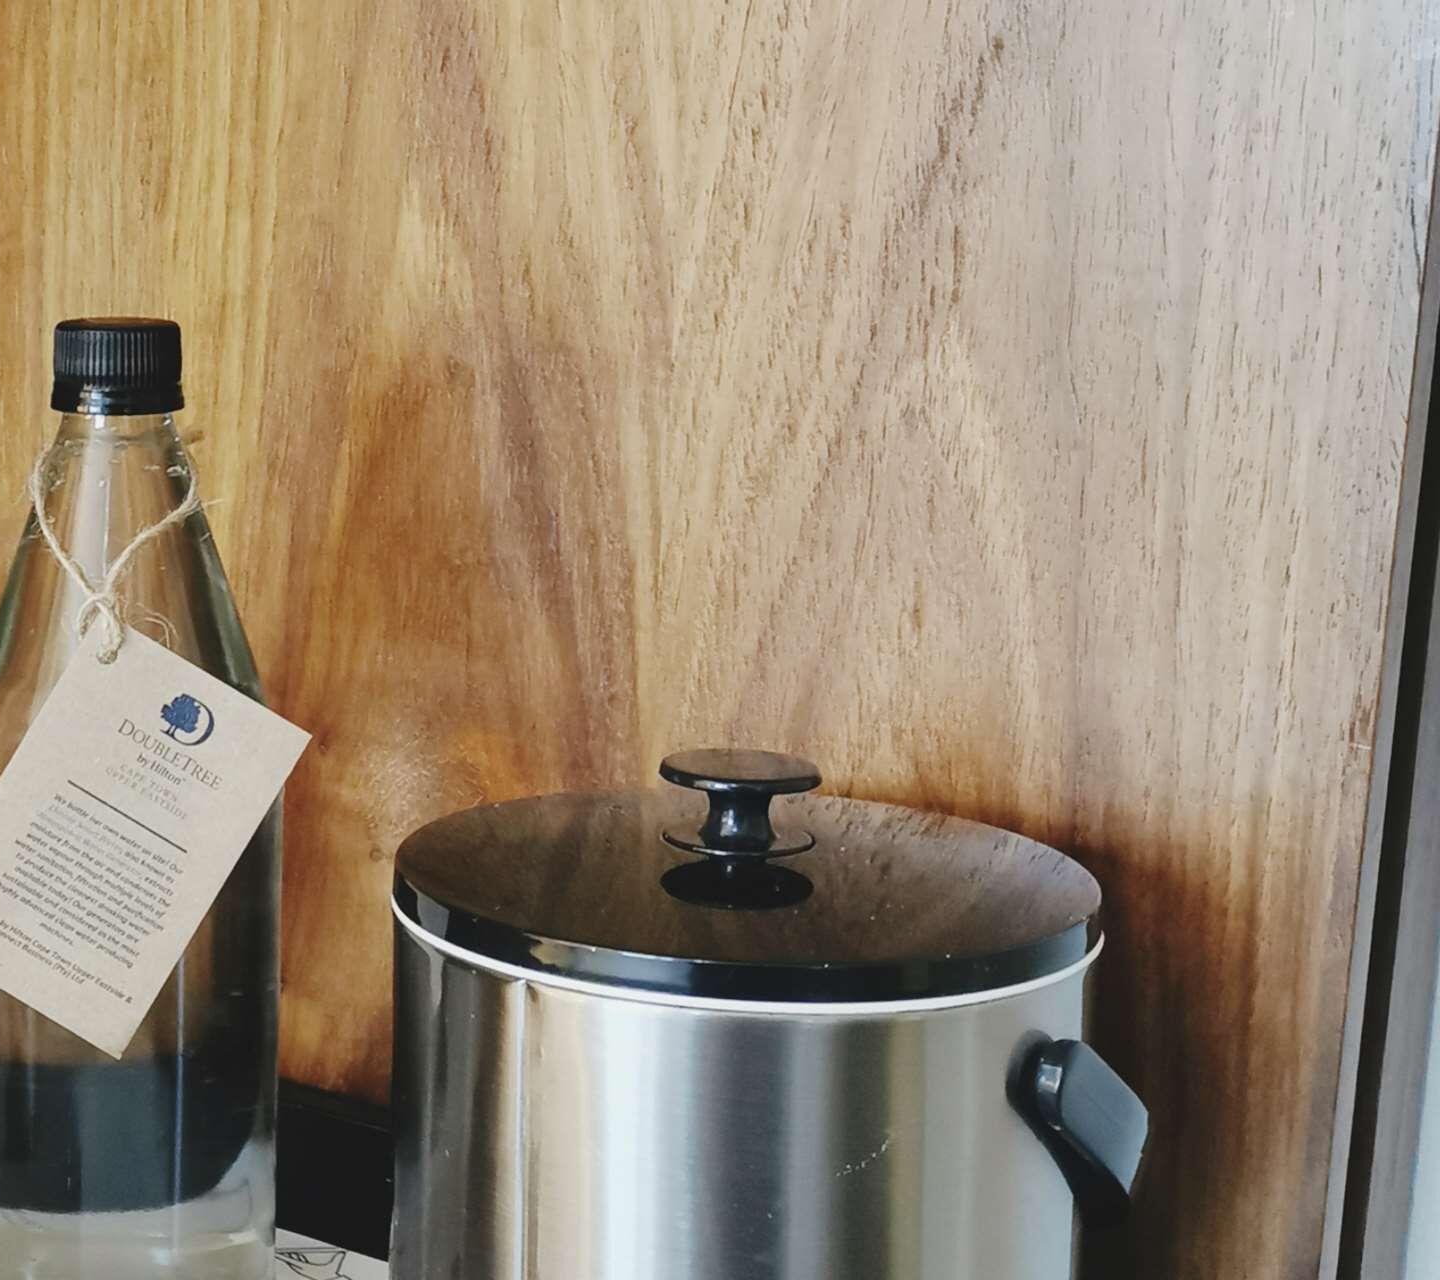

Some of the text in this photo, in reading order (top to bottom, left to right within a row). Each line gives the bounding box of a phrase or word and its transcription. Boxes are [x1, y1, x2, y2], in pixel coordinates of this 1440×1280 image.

[118, 762, 180, 804] CAPE TOWN
[134, 752, 150, 768] by
[14, 837, 37, 855] water
[107, 892, 124, 907] and
[25, 831, 49, 849] water
[73, 859, 105, 883] through
[102, 877, 134, 901] multiple
[133, 895, 156, 913] levels
[152, 906, 166, 920] of
[29, 819, 64, 844] moisture
[60, 838, 82, 856] from
[80, 850, 95, 863] the
[104, 864, 122, 879] and
[157, 896, 172, 909] the
[66, 800, 91, 819] bottle
[101, 823, 119, 837] own
[118, 832, 143, 851] water
[141, 847, 152, 857] on
[167, 862, 185, 876] Our
[139, 858, 166, 878] known
[164, 875, 175, 884] as
[1, 870, 45, 900] sustainable
[43, 895, 60, 909] and
[57, 904, 99, 933] considered
[97, 929, 107, 938] as
[106, 933, 121, 946] the
[13, 864, 49, 889] available
[72, 899, 88, 912] Our
[85, 907, 127, 937] generators
[125, 932, 139, 944] are
[15, 852, 26, 861] to
[23, 856, 55, 880] produce
[53, 874, 68, 887] the
[96, 901, 129, 925] drinking
[127, 919, 151, 937] water
[18, 894, 56, 921] advanced
[54, 915, 76, 932] clean
[74, 928, 98, 946] water
[94, 941, 135, 970] producing
[8, 924, 33, 943] Hilton
[31, 938, 51, 955] Cape
[50, 950, 72, 967] Town
